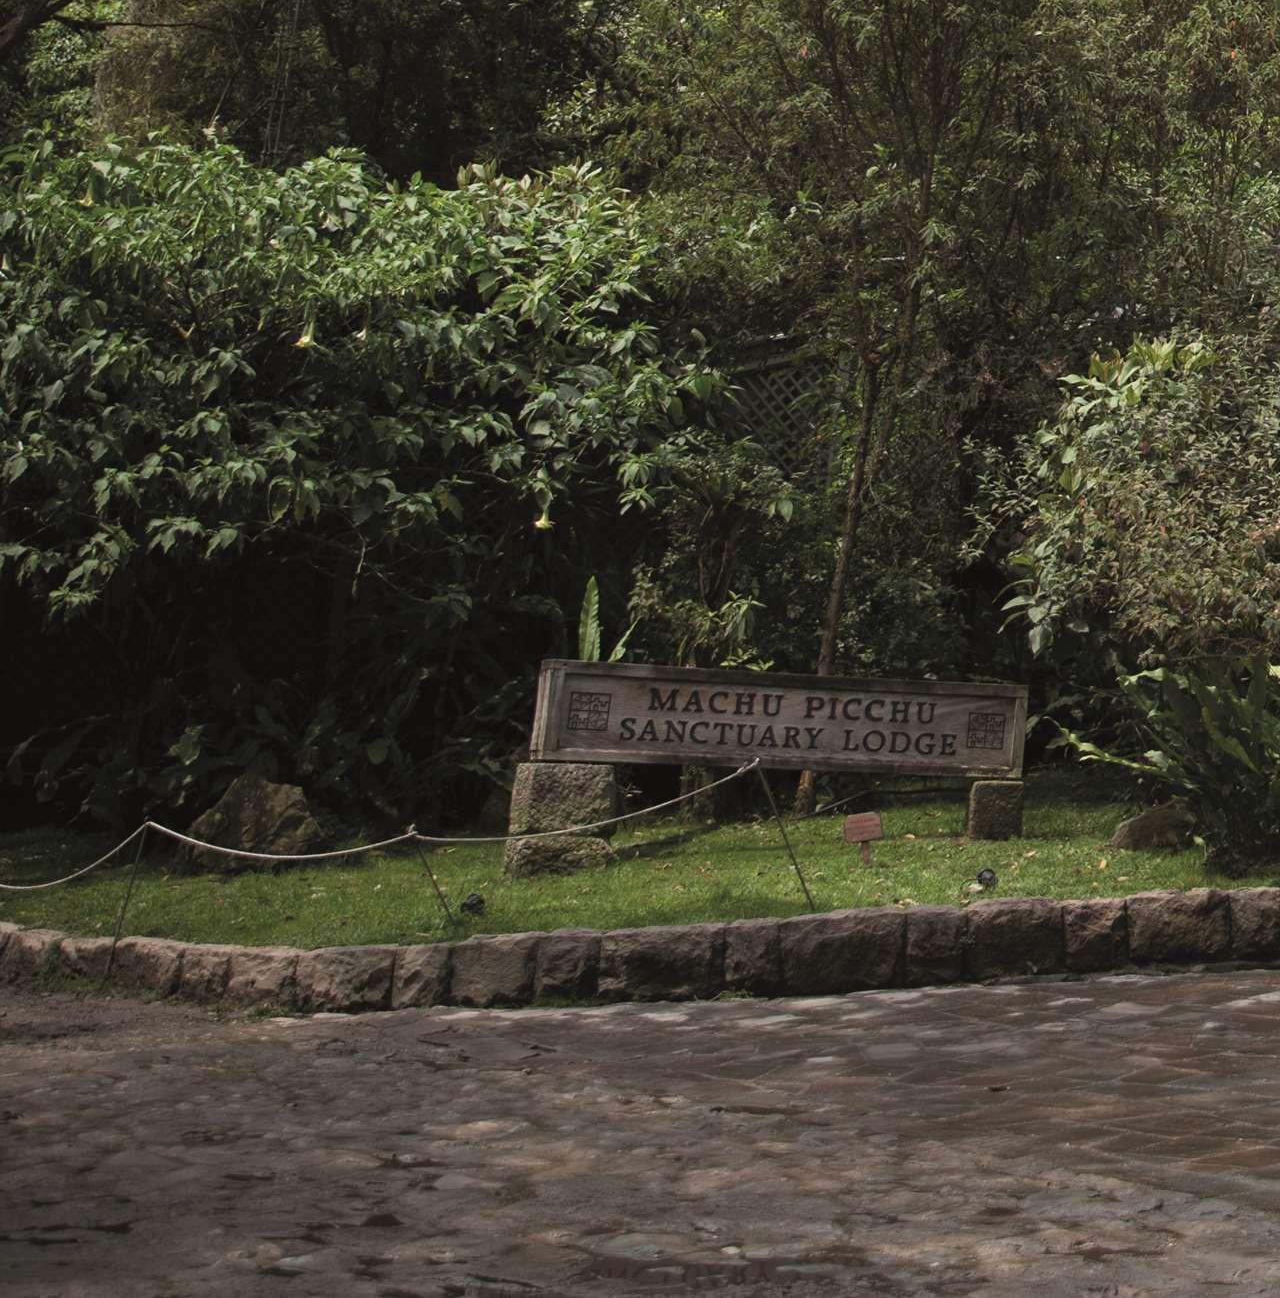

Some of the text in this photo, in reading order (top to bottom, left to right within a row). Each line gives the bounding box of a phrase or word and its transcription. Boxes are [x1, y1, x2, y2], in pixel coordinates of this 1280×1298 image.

[648, 687, 938, 724] MACHU PICCHU
[619, 717, 957, 756] SANCTUARY LODGE
